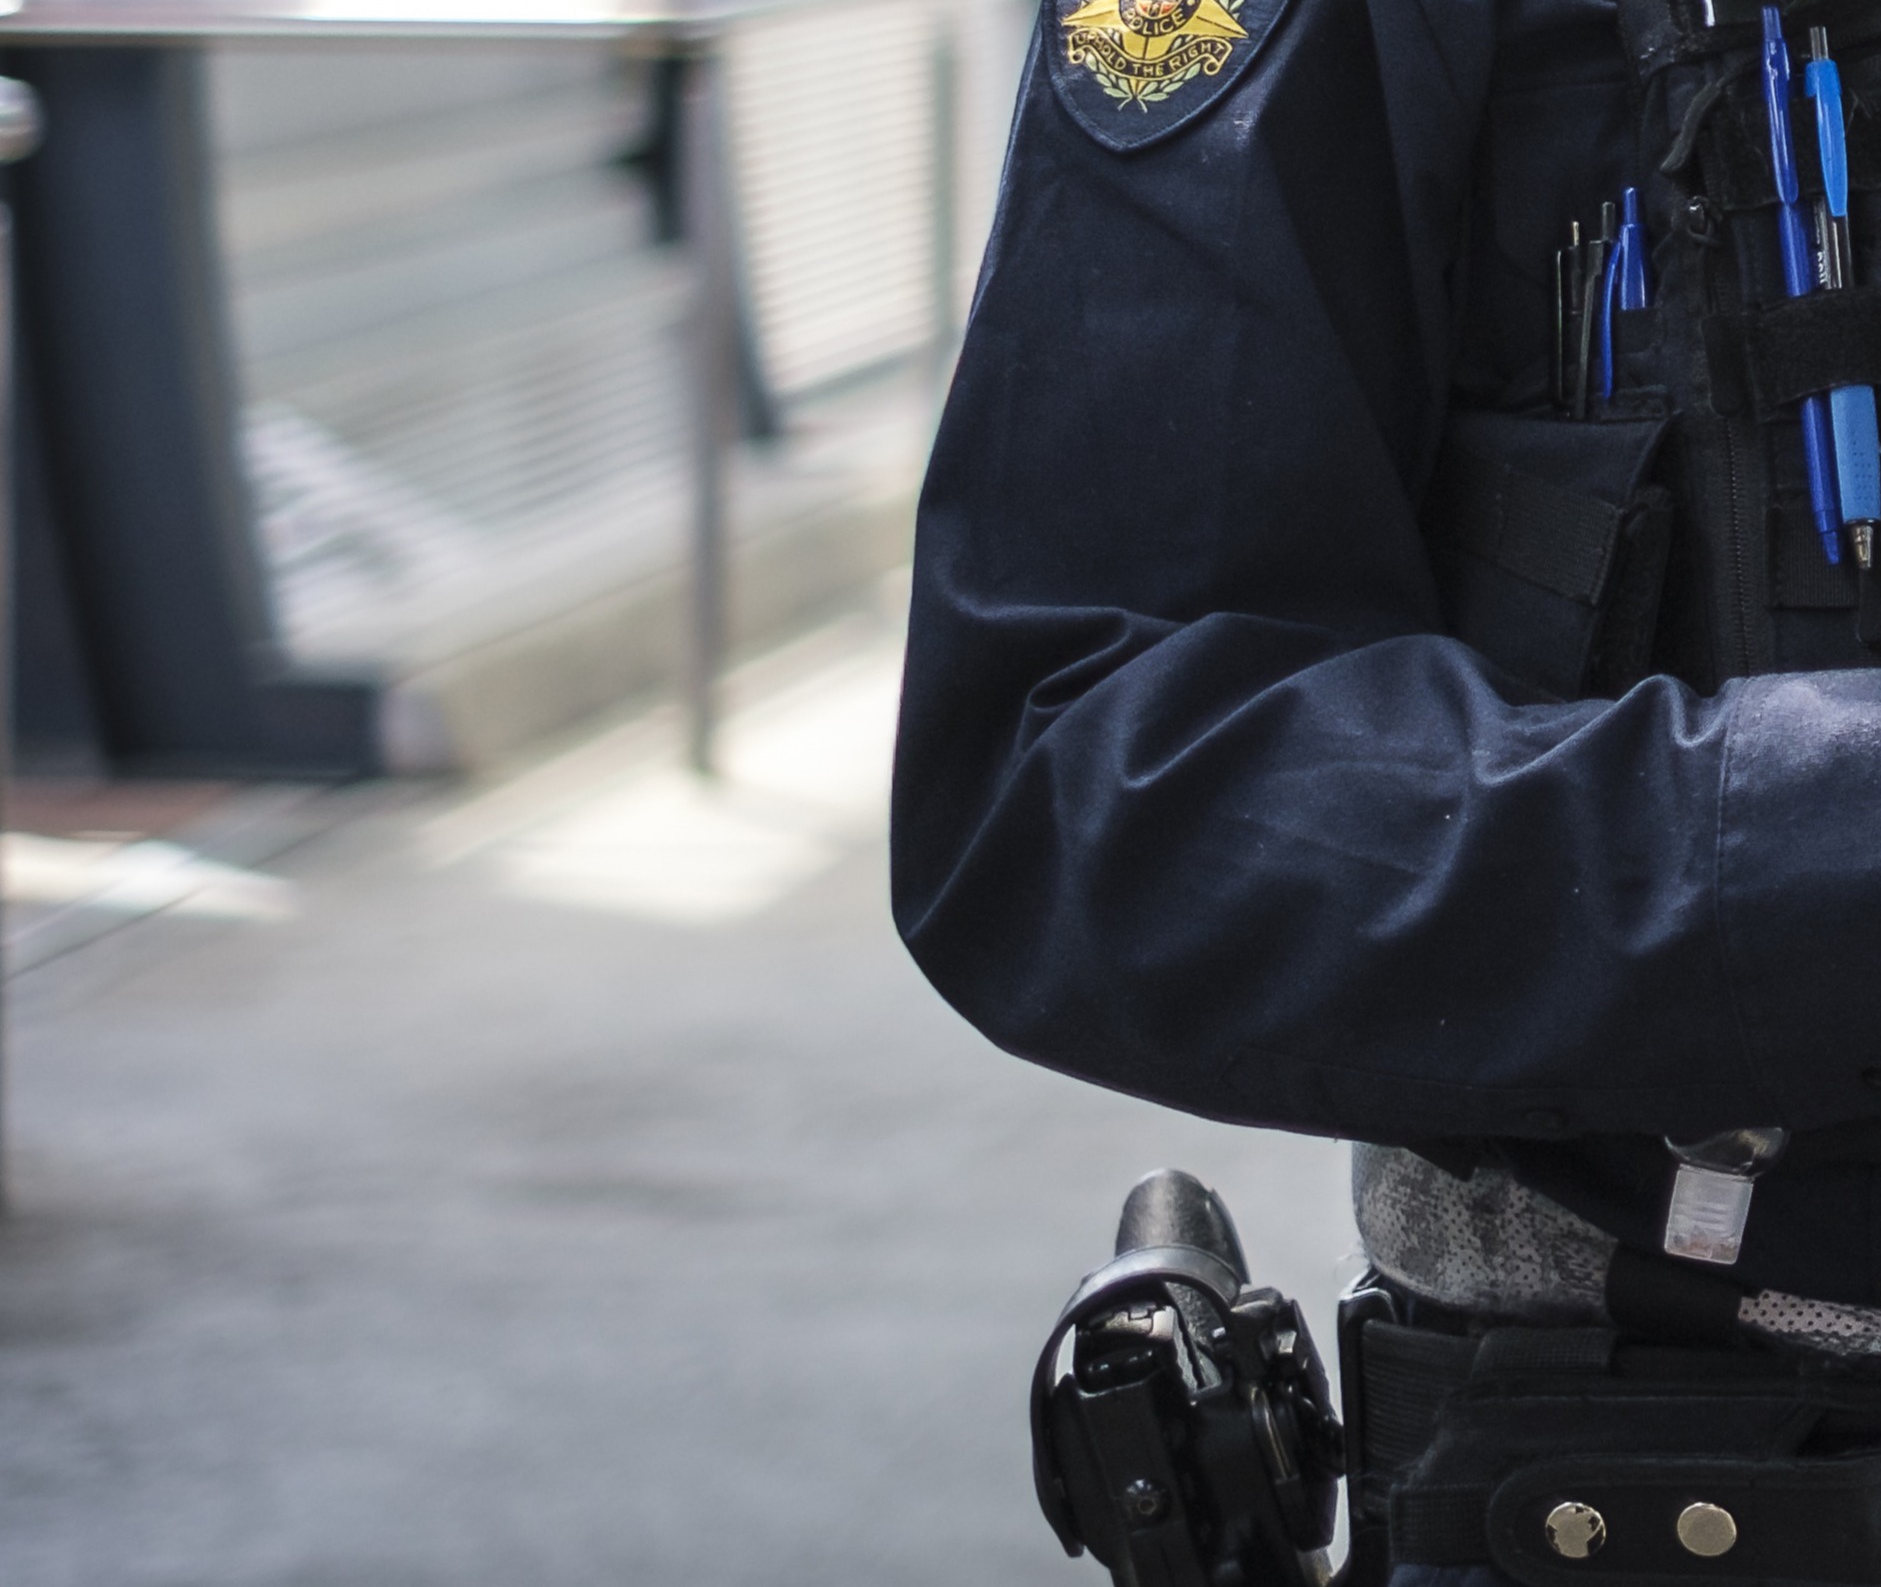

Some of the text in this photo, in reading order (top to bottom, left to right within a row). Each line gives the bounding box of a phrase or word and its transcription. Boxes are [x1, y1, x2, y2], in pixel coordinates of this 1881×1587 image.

[1123, 7, 1186, 36] POLICE
[1075, 32, 1225, 77] UPHOLD THE RIGHT
